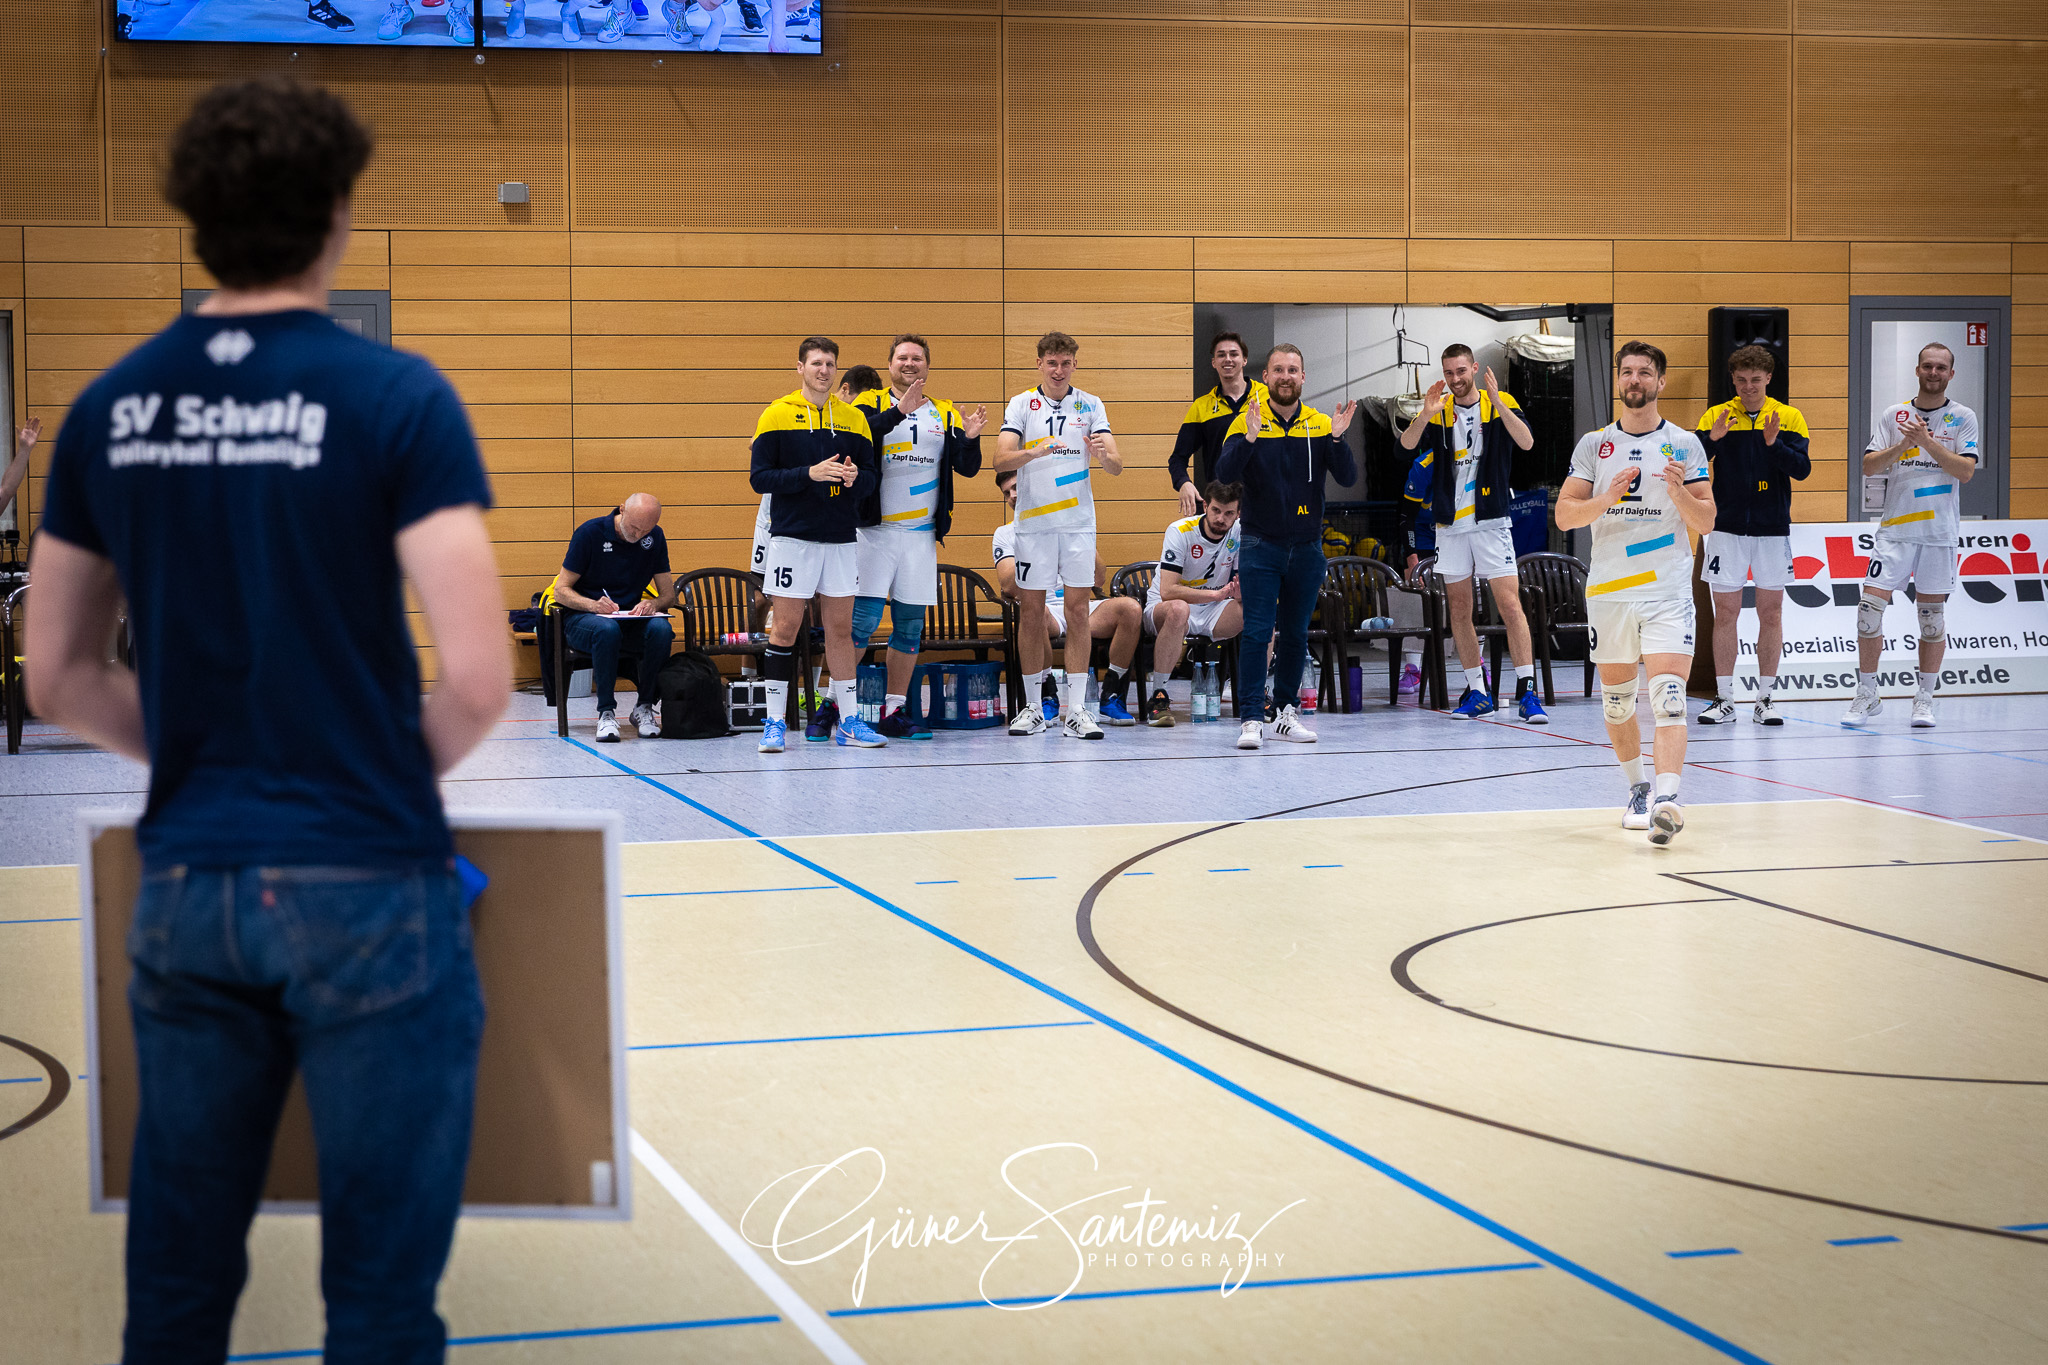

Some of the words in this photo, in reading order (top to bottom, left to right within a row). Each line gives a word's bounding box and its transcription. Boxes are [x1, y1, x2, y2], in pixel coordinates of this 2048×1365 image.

[110, 393, 162, 440] SV
[174, 391, 328, 445] Schwaig
[1045, 415, 1067, 436] 17
[909, 423, 918, 445] 1
[892, 453, 908, 461] Zapf
[908, 454, 935, 463] Daigfuss
[830, 485, 840, 497] JU
[1481, 487, 1491, 496] M
[1758, 480, 1768, 491] JD
[1297, 505, 1309, 515] AL
[1606, 507, 1625, 515] Zapf
[1625, 507, 1662, 516] Daigfuss
[754, 545, 765, 564] 5
[774, 567, 793, 588] 15
[1015, 561, 1031, 582] 17
[1203, 560, 1216, 580] 2
